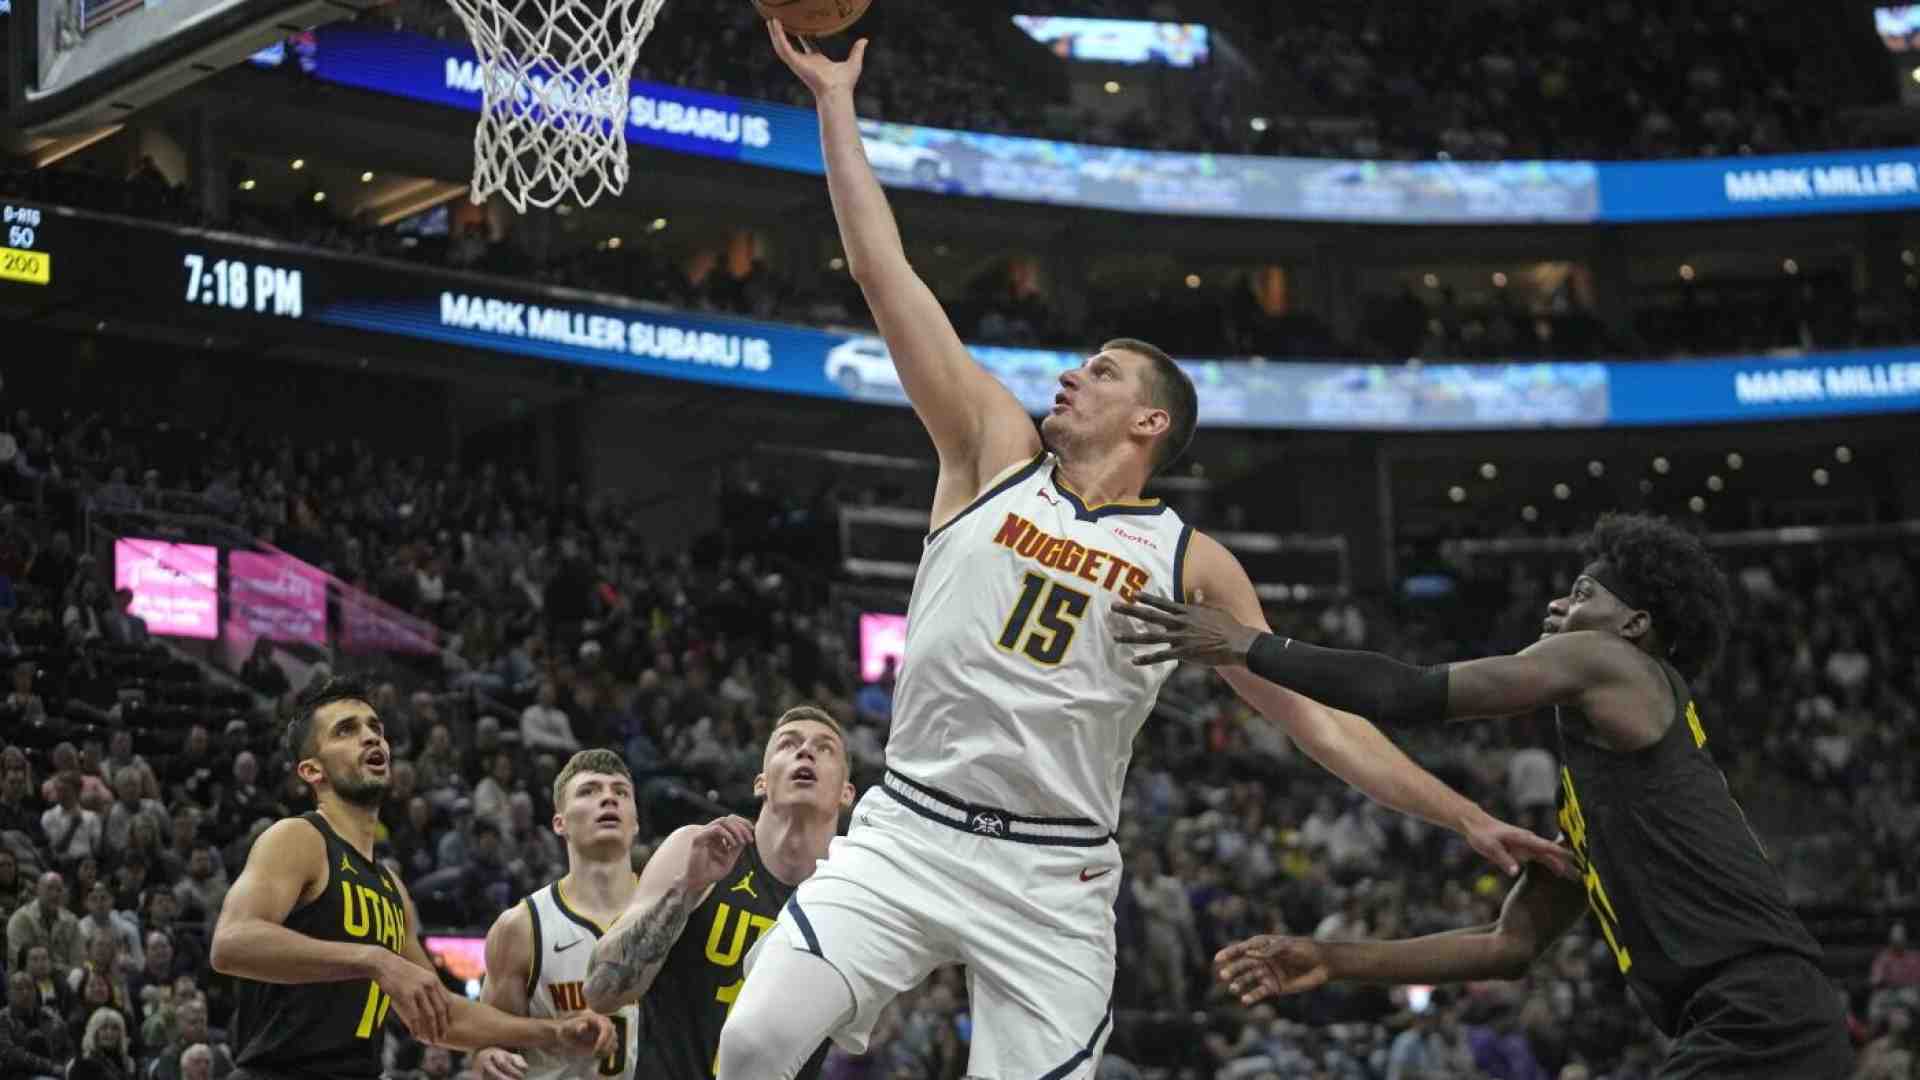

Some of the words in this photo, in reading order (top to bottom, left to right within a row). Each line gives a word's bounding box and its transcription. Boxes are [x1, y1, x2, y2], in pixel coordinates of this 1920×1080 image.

[629, 96, 739, 142] SUBARU
[742, 115, 770, 147] IS
[1725, 169, 1812, 202] MARK
[1812, 162, 1917, 197] MILLER
[4, 253, 41, 275] 200
[184, 254, 248, 309] 7:18
[254, 264, 303, 319] PM
[440, 291, 526, 336] MARK
[527, 306, 627, 352] MILLER
[628, 322, 740, 368] SUBARU
[743, 338, 772, 371] IS
[1735, 367, 1825, 405] MARK
[992, 511, 1152, 607] NUGGETS
[997, 570, 1091, 668] 15
[342, 881, 405, 954] UTAH
[705, 902, 777, 966] UT
